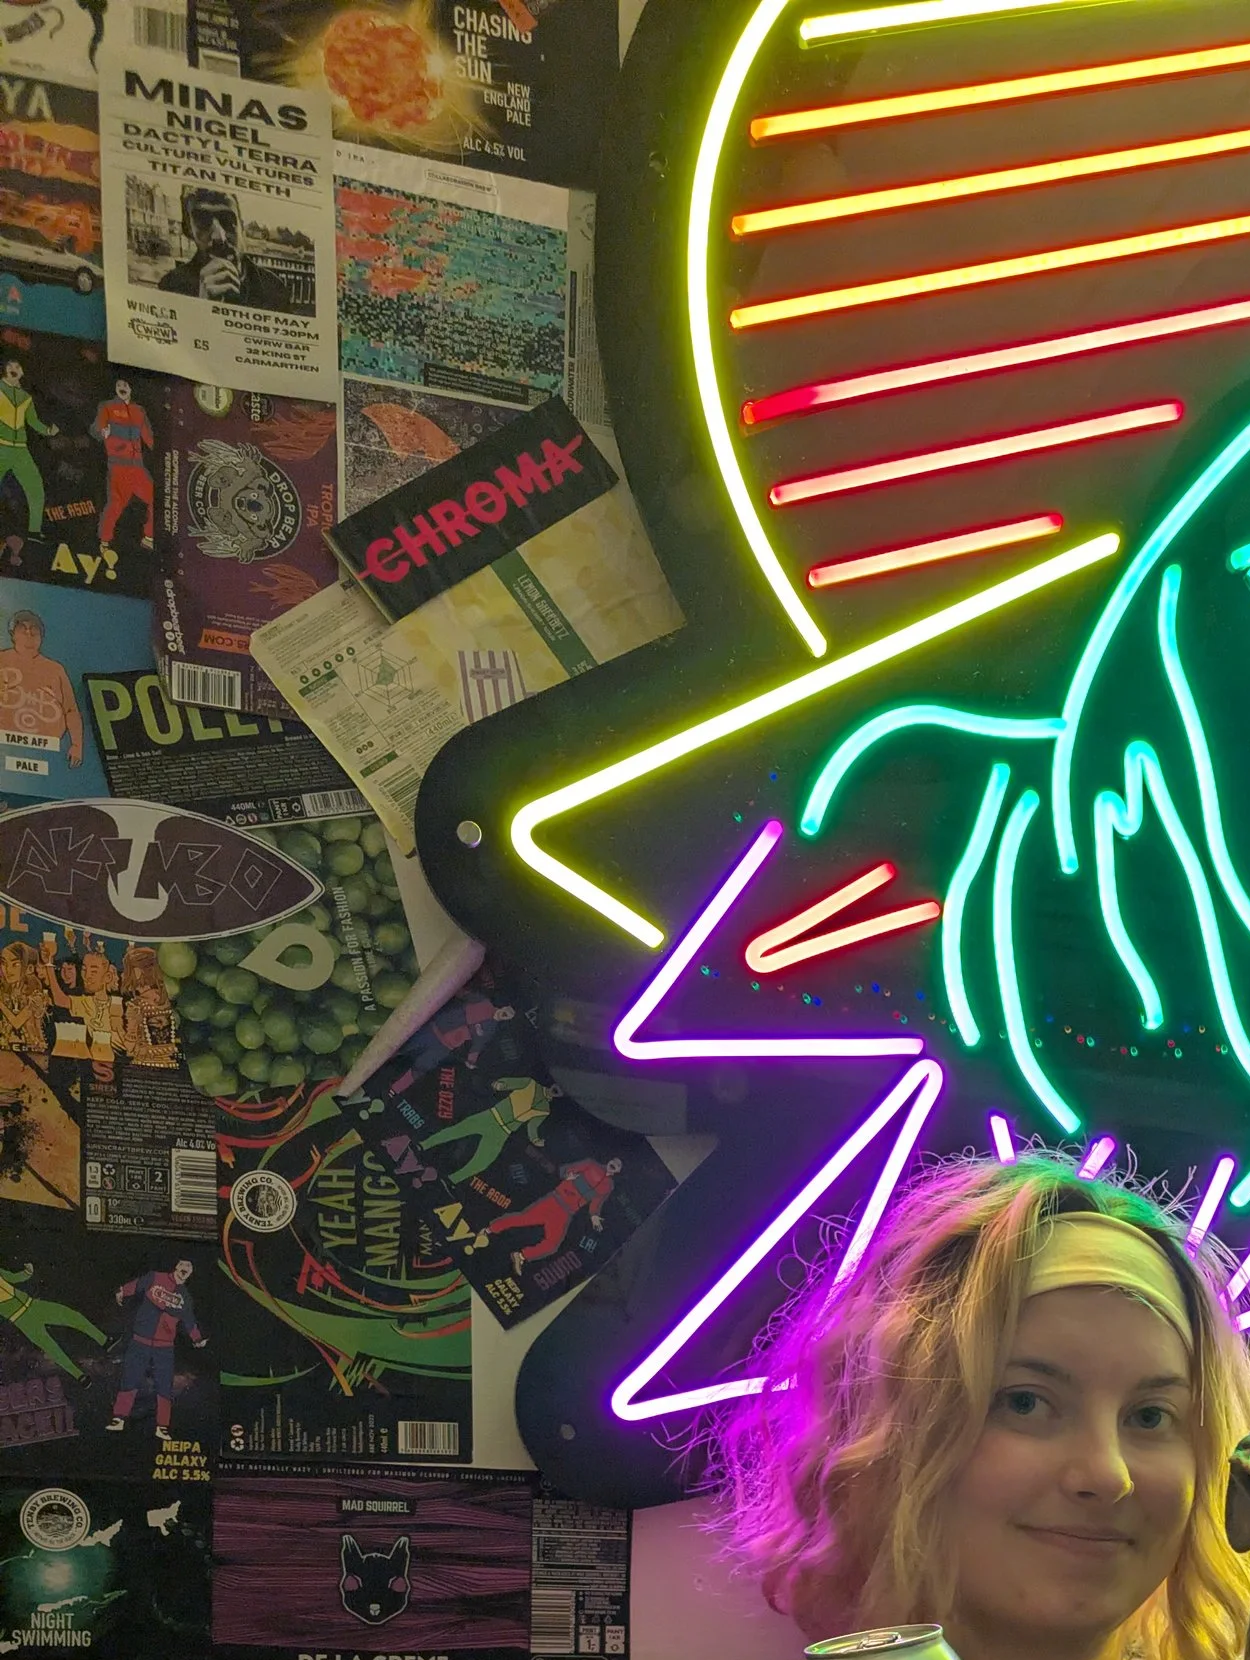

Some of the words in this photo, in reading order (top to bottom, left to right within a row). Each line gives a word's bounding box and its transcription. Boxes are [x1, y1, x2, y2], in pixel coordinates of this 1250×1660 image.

[454, 29, 488, 59] THE
[455, 57, 492, 84] SUN
[123, 68, 310, 132] MINAS
[507, 81, 530, 98] NEW
[484, 90, 531, 113] ENGLAND
[165, 109, 271, 149] NIGEL
[506, 109, 531, 128] PALE
[122, 122, 230, 155] DACTYL
[234, 145, 319, 175] TERRA
[463, 138, 482, 154] ALC
[507, 146, 527, 162] VOL
[121, 140, 212, 165] CULTURE
[212, 156, 317, 188] VULTURES
[148, 159, 216, 183] TITAN
[221, 173, 292, 199] TEETH
[223, 319, 270, 334] DOORS
[252, 313, 273, 324] OF
[274, 317, 310, 330] MAY
[192, 339, 211, 352] £5
[243, 336, 281, 351] CWRW
[284, 341, 312, 353] BAR
[244, 346, 260, 358] 32
[261, 348, 291, 361] KING
[291, 353, 308, 363] ST
[234, 355, 321, 374] CARMARTHEN
[268, 470, 297, 514] DROP
[45, 506, 63, 521] THE
[359, 434, 585, 584] CHROMA
[271, 514, 297, 550] BEAR
[4, 732, 29, 747] TAPS
[31, 737, 49, 749] AFF
[15, 759, 40, 773] PALE
[332, 885, 353, 936] FASHION
[352, 957, 375, 1003] PASSION
[469, 1175, 489, 1196] THE
[318, 1164, 358, 1250] YEAH
[492, 1276, 519, 1308] GALAXY
[161, 1439, 202, 1455] NEIPA
[154, 1453, 208, 1469] GALAXY
[151, 1467, 178, 1482] ALC
[180, 1468, 212, 1483] 5.5%
[341, 1499, 364, 1513] MAD
[365, 1500, 411, 1514] SQUIRREL
[29, 1611, 75, 1630] NIGHT
[10, 1628, 93, 1649] SWIMMING
